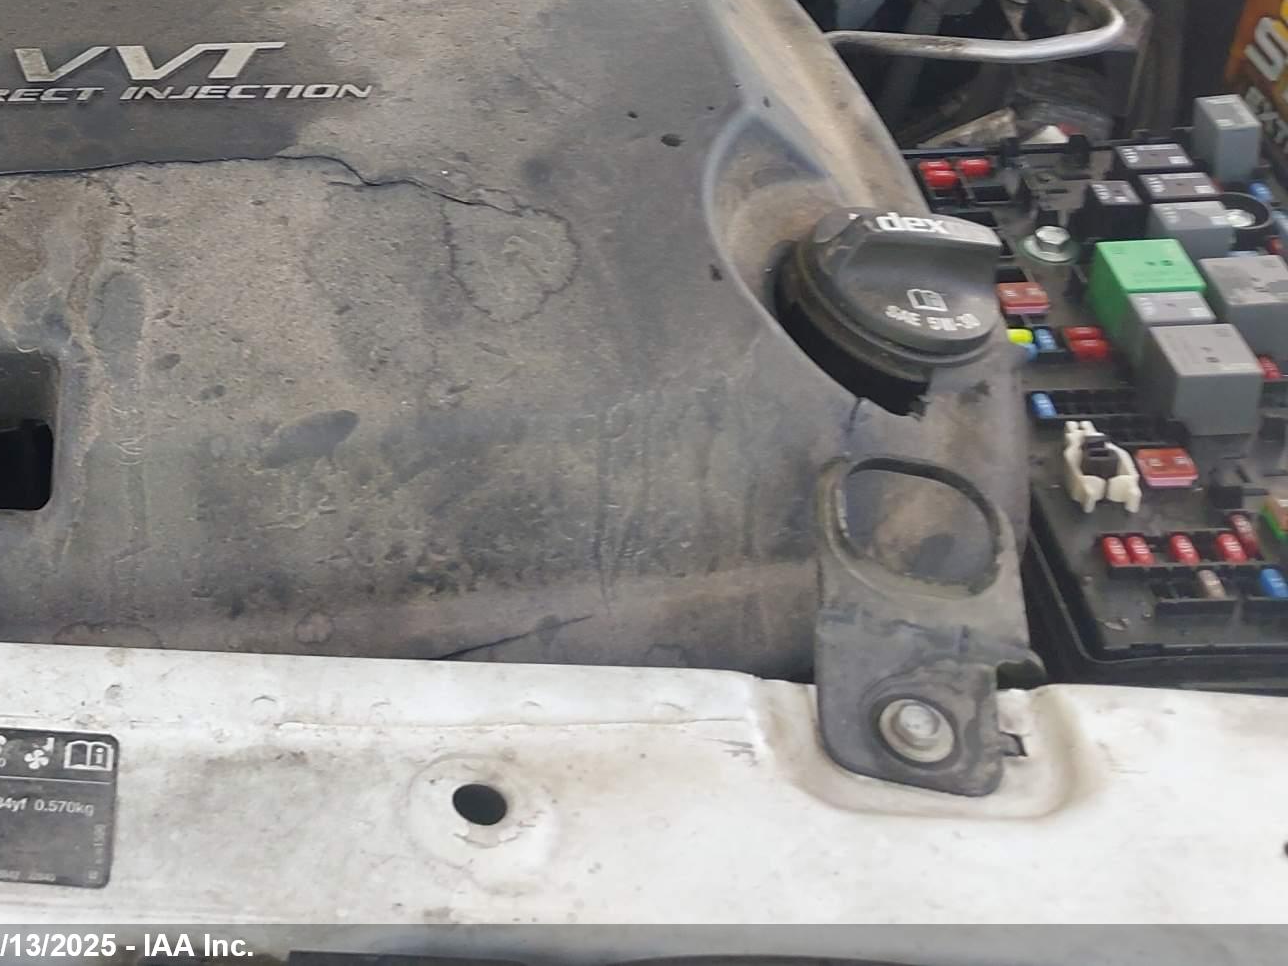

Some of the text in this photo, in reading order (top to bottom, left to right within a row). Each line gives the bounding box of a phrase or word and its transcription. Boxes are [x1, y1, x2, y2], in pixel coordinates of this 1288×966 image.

[13, 41, 286, 82] VVT
[119, 83, 373, 101] INJECTION
[885, 305, 922, 326] SAE
[34, 799, 95, 817] 0.570kg
